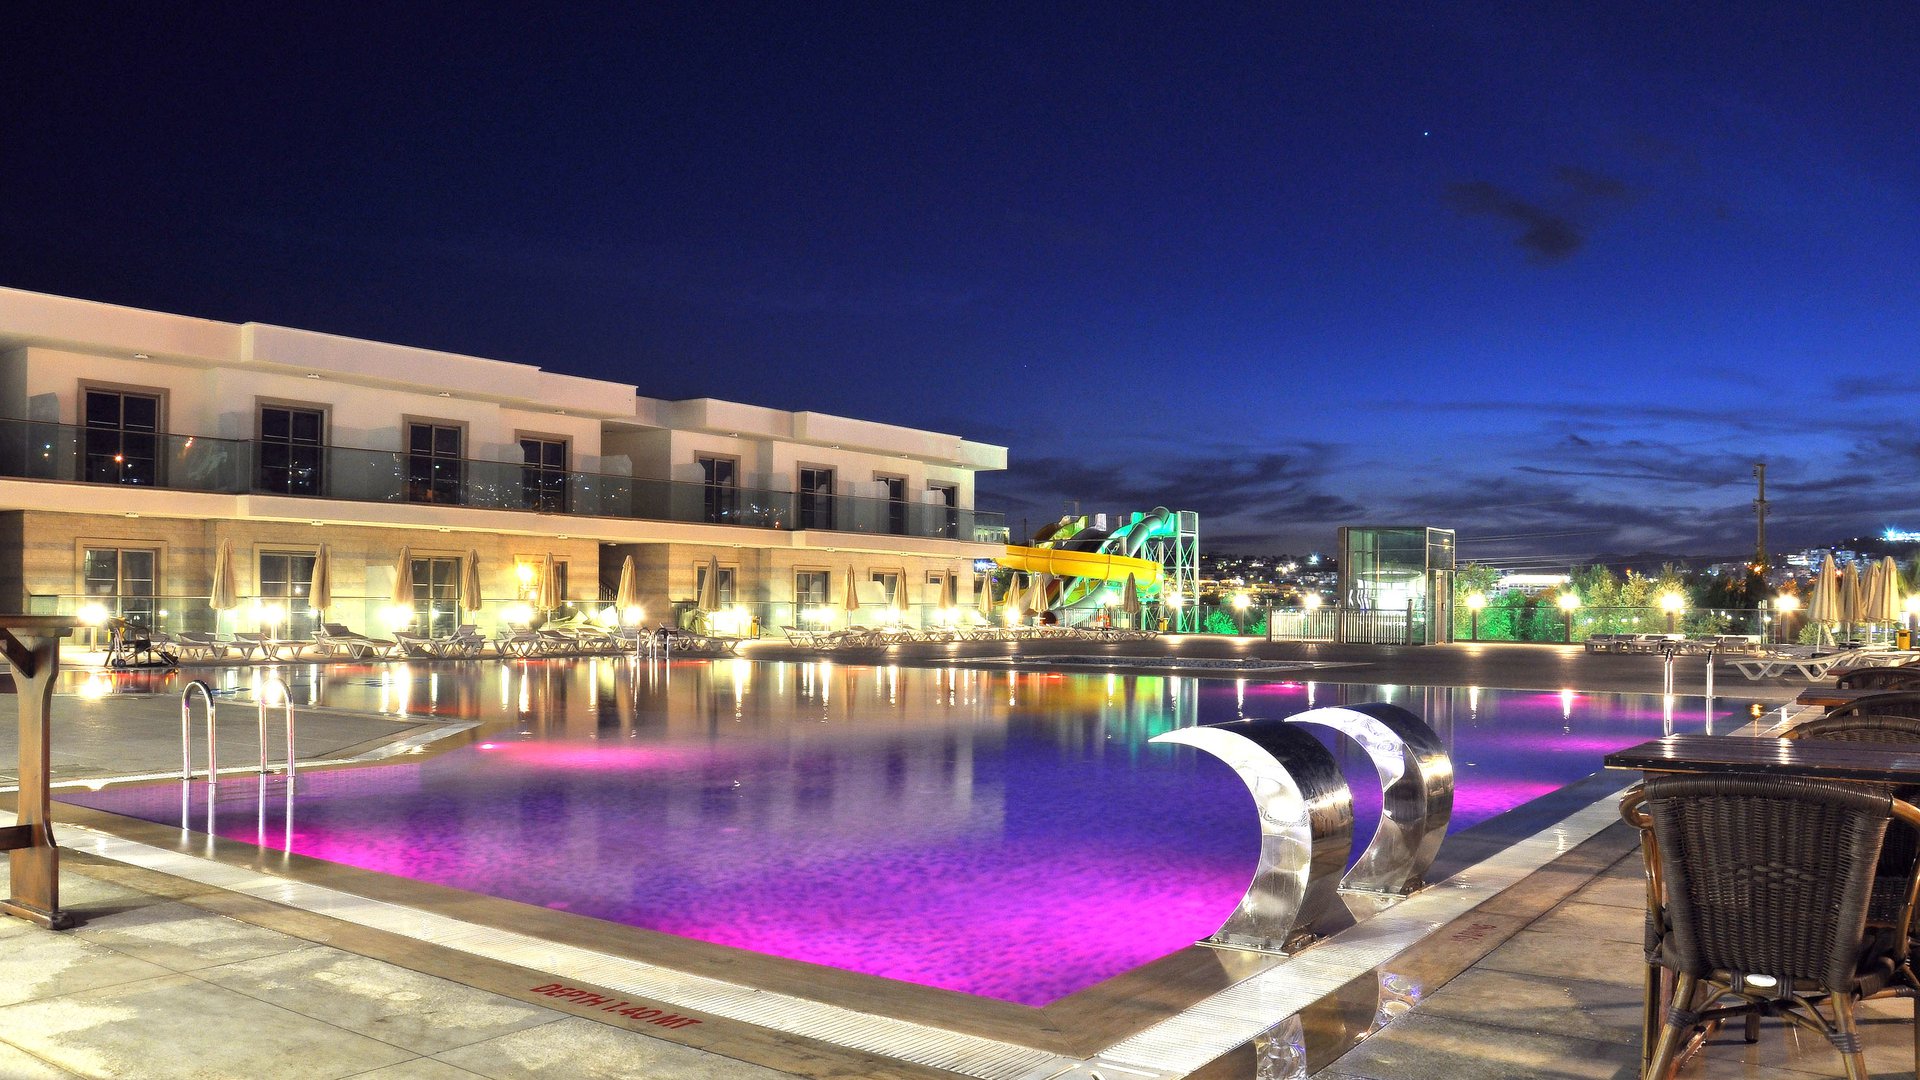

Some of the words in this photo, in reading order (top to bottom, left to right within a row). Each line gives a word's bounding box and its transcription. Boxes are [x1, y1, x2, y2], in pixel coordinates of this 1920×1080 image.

[530, 983, 615, 1007] DEPTH
[601, 1001, 663, 1020] 1.40
[646, 1014, 703, 1029] MT
